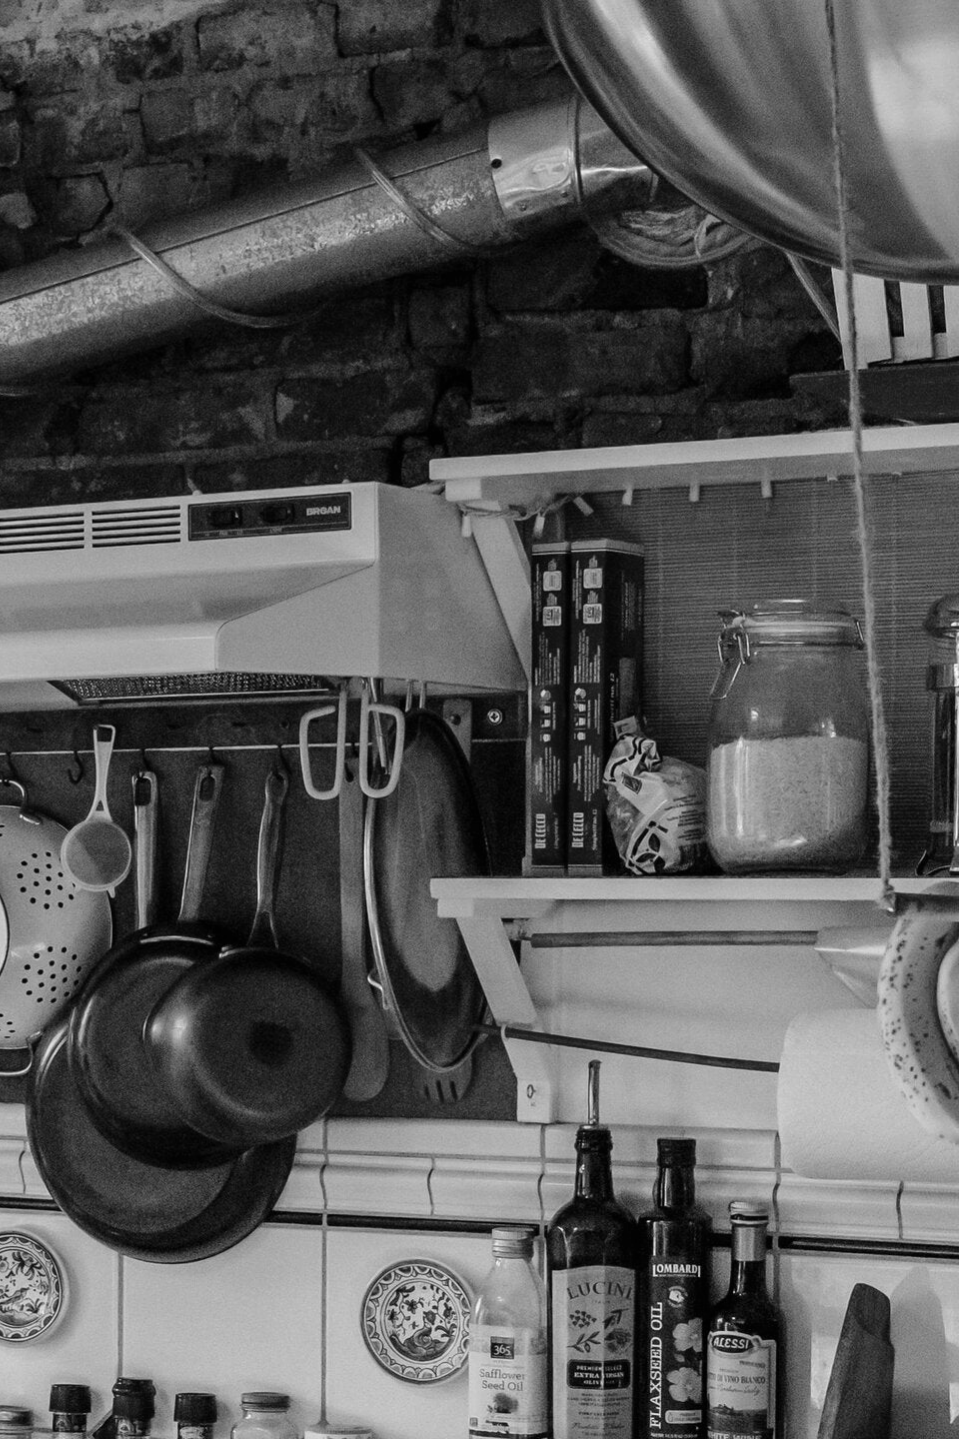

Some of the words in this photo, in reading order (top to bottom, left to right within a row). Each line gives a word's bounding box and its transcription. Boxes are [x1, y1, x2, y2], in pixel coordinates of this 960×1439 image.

[535, 813, 546, 838] CECCO
[572, 812, 584, 836] CECCO
[652, 1263, 701, 1278] LOMBARDI
[567, 1282, 632, 1300] LUCINI
[650, 1302, 663, 1331] OIL
[493, 1344, 512, 1356] 365
[713, 1337, 749, 1349] ALESSI
[479, 1369, 525, 1380] Safflower
[741, 1375, 766, 1384] BIANCO
[482, 1380, 505, 1391] Seed
[507, 1381, 524, 1391] Oil
[649, 1336, 663, 1429] FLAXSEED
